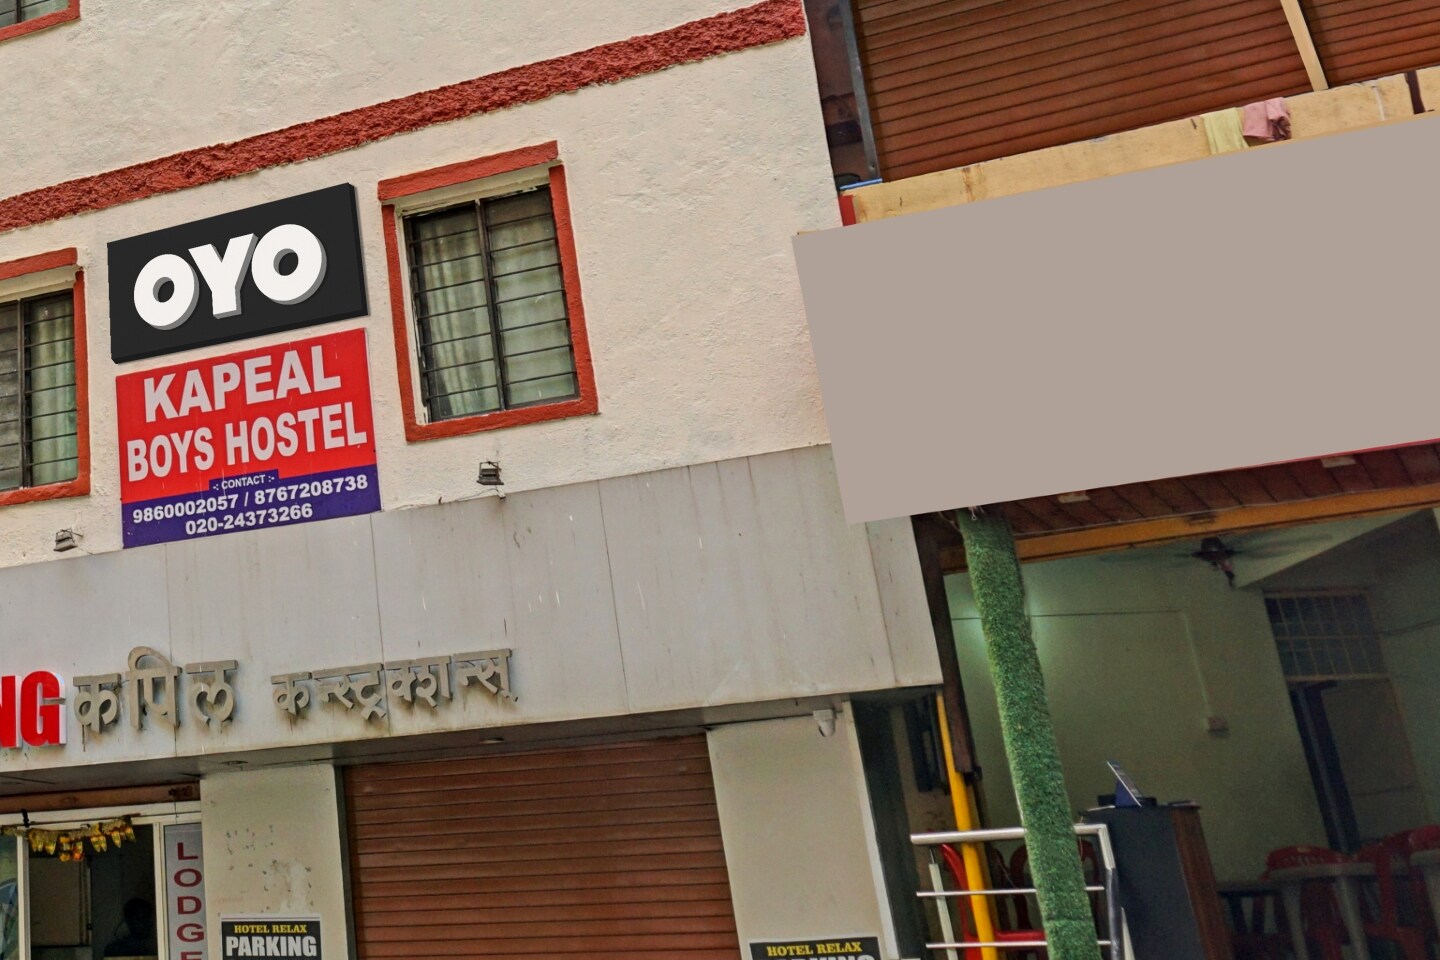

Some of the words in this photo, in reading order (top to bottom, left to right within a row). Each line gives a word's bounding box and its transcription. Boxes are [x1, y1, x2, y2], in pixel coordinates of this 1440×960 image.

[134, 224, 326, 330] OYO
[143, 344, 342, 423] KAPEAL
[126, 426, 215, 482] BOYS
[225, 401, 368, 466] HOSTEL
[132, 493, 239, 524] 9860002057
[254, 474, 368, 505] 8767208738
[221, 474, 266, 490] CONTACT
[185, 502, 313, 535] 020-24373266
[73, 646, 239, 734] कपिल
[225, 936, 317, 957] PARKING
[234, 924, 269, 934] HOTEL
[272, 924, 307, 934] RELAX
[766, 944, 813, 956] HOTEL
[816, 941, 863, 954] RELAX
